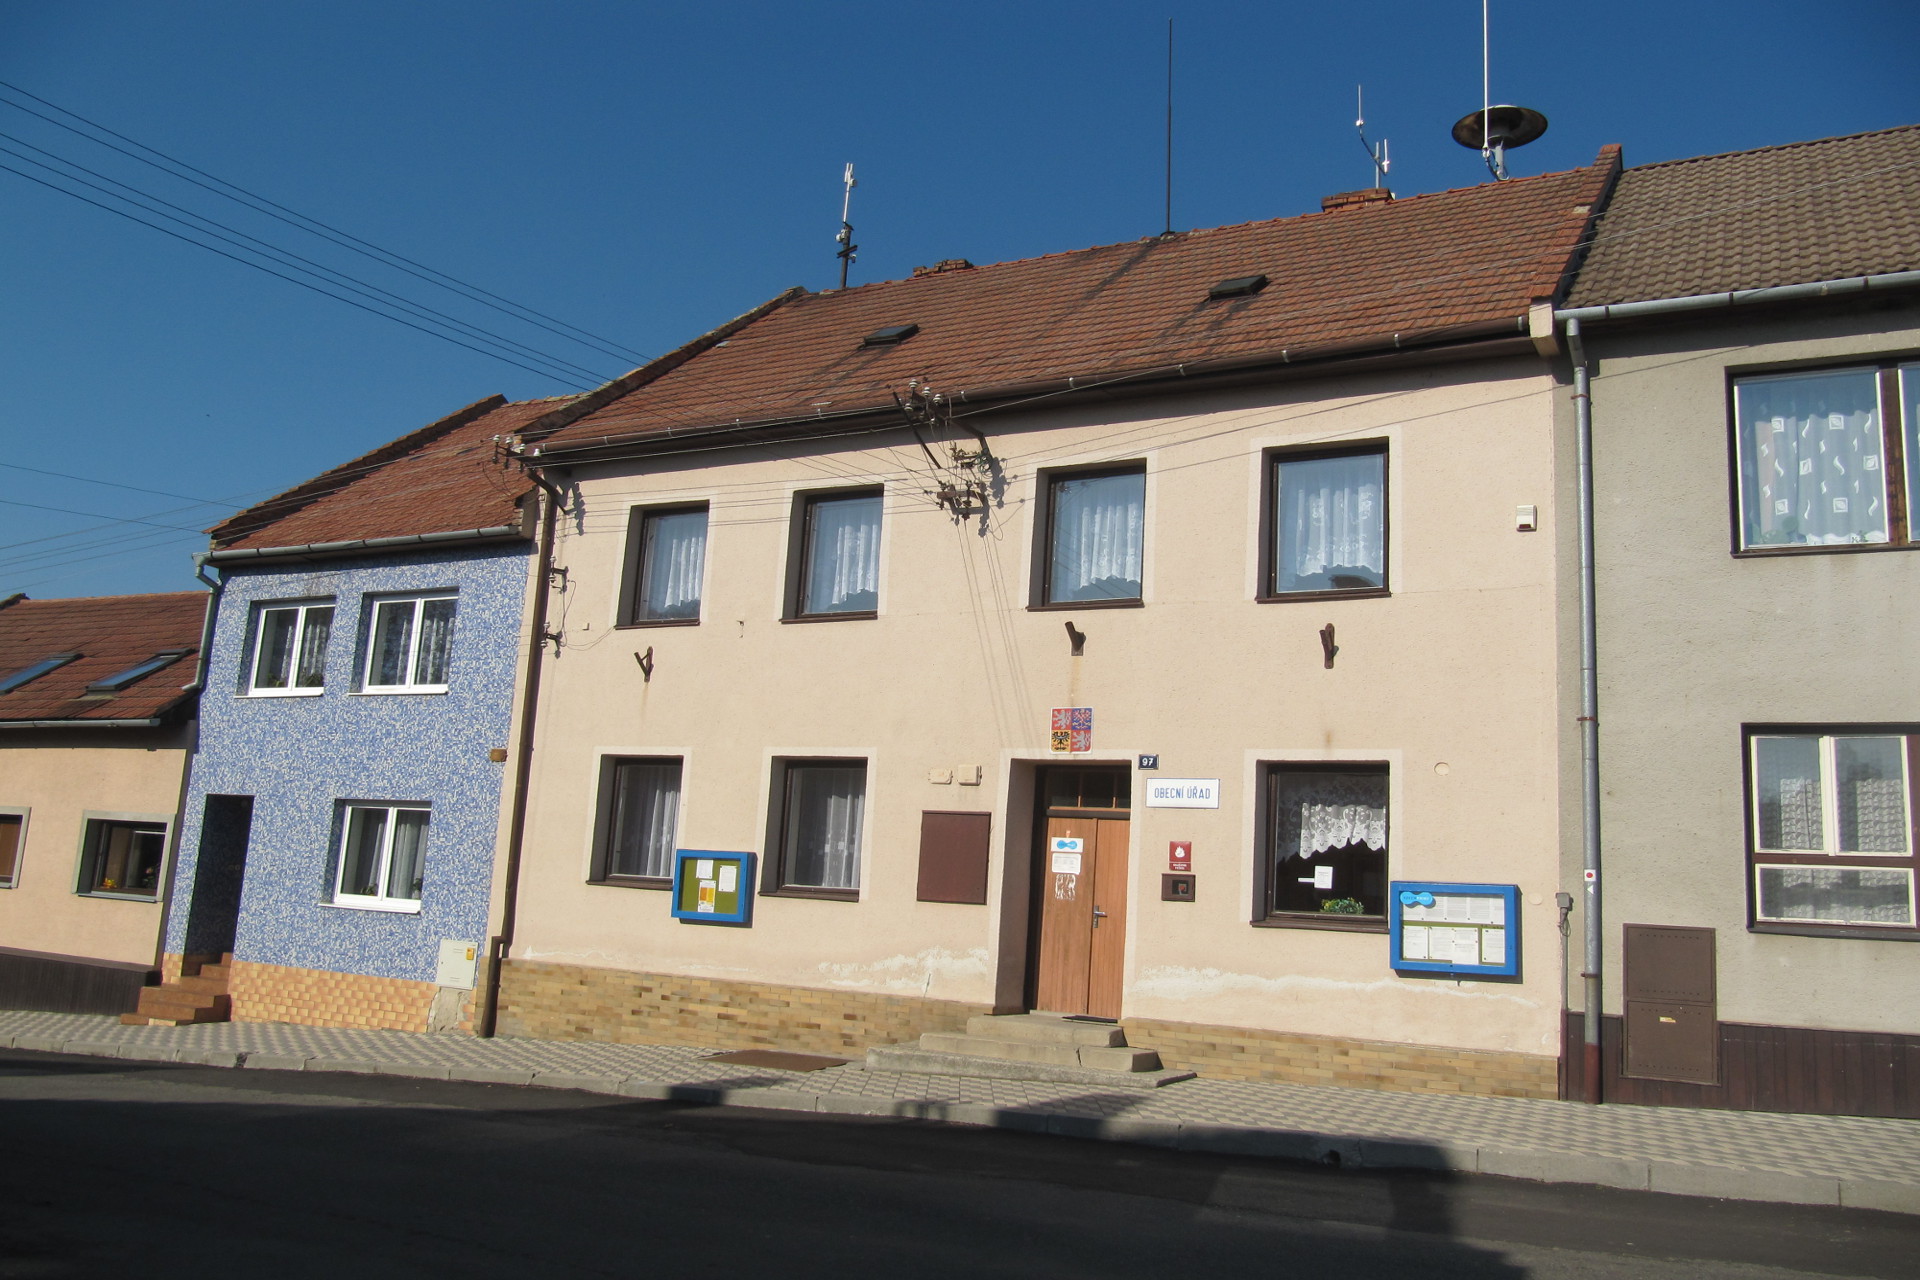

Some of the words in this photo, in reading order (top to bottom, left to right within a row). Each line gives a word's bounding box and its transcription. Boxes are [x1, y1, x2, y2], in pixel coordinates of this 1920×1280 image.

[1142, 757, 1154, 766] 97
[1154, 785, 1184, 799] OBECNÍ
[1186, 785, 1211, 800] ÚŘAD
